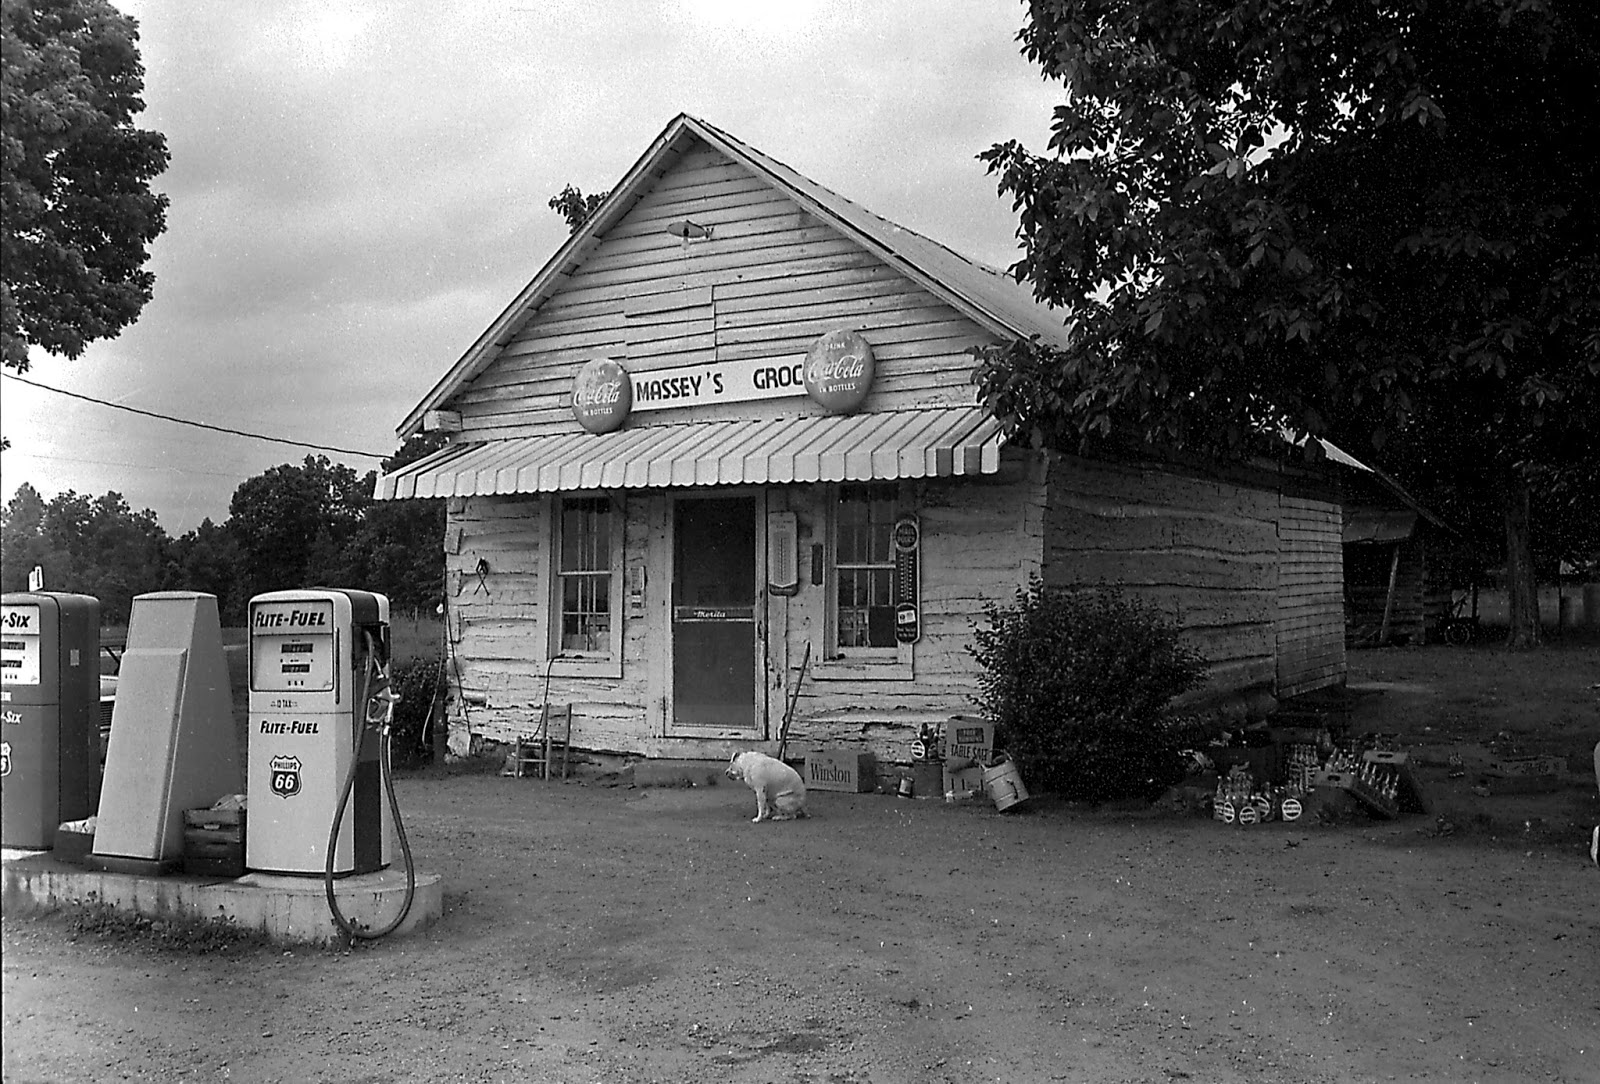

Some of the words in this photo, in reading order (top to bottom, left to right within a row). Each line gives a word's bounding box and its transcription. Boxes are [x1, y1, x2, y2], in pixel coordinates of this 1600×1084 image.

[636, 371, 724, 402] MASSEY'S
[829, 383, 856, 392] BOTTLES
[275, 774, 296, 789] 66
[810, 763, 850, 783] Winston
